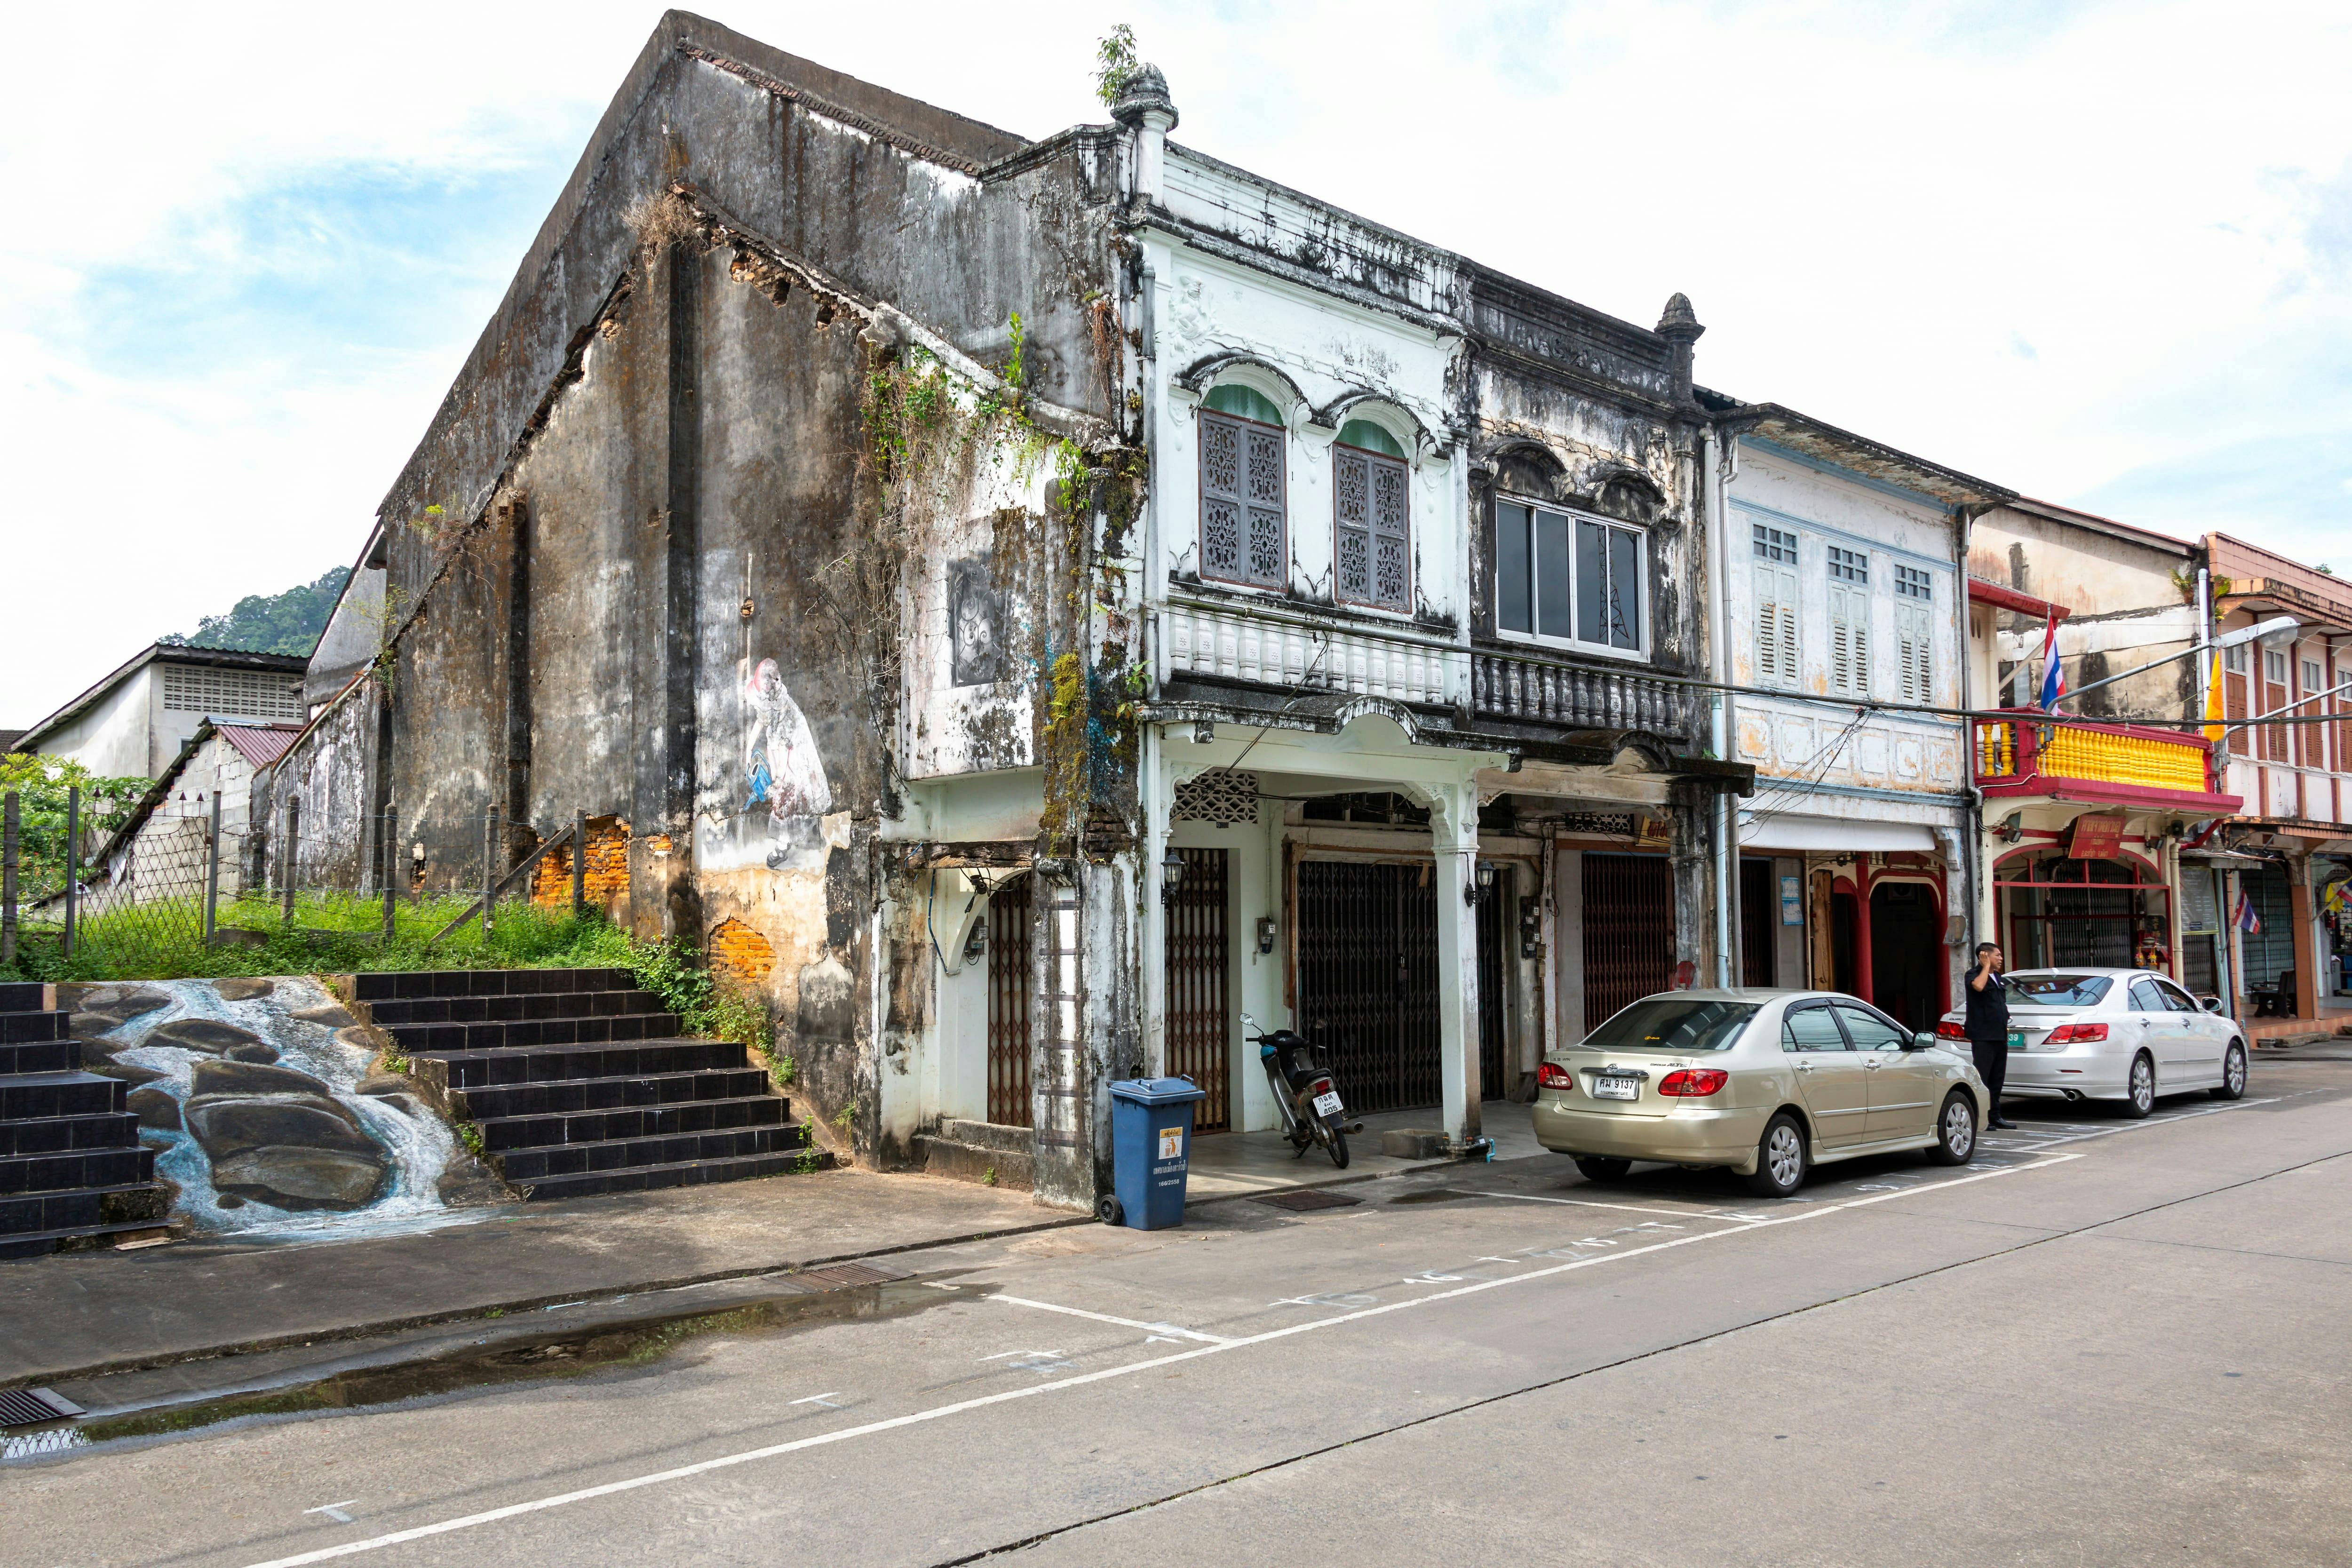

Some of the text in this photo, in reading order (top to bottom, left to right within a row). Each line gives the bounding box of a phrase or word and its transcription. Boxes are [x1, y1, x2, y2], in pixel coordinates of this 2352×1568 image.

[1614, 1079, 1634, 1089] 9137
[1324, 1105, 1338, 1114] 405
[1158, 1178, 1180, 1187] 166/2558
